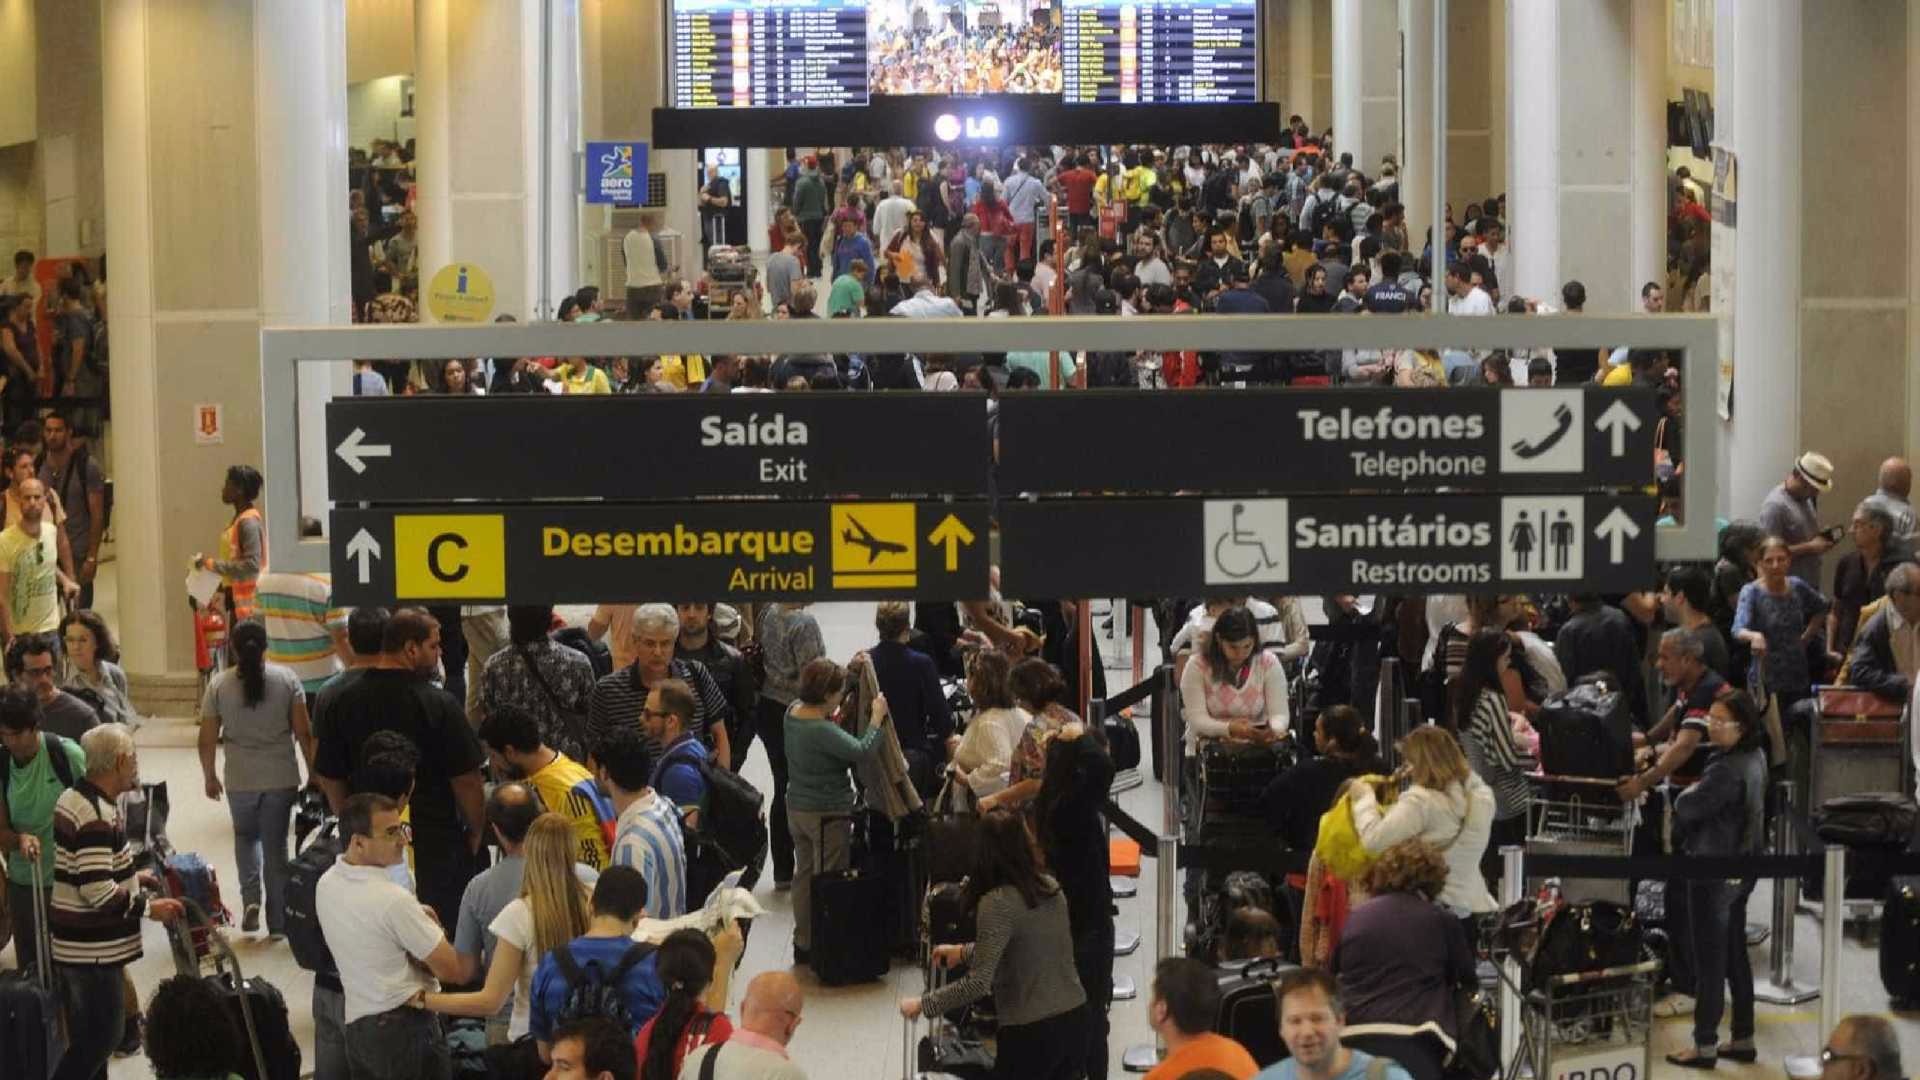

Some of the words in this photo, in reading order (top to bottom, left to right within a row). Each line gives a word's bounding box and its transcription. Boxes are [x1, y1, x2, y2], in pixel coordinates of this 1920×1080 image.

[966, 116, 998, 137] LG
[600, 178, 633, 188] aero
[700, 412, 808, 446] Saída
[1297, 406, 1484, 440] Telefones
[759, 457, 808, 483] Exit
[1350, 451, 1486, 480] Telephone
[542, 523, 815, 562] Desembarque
[1295, 514, 1492, 549] Sanitários
[427, 532, 469, 583] C
[1351, 559, 1491, 584] Restrooms
[728, 565, 814, 591] Arrival
